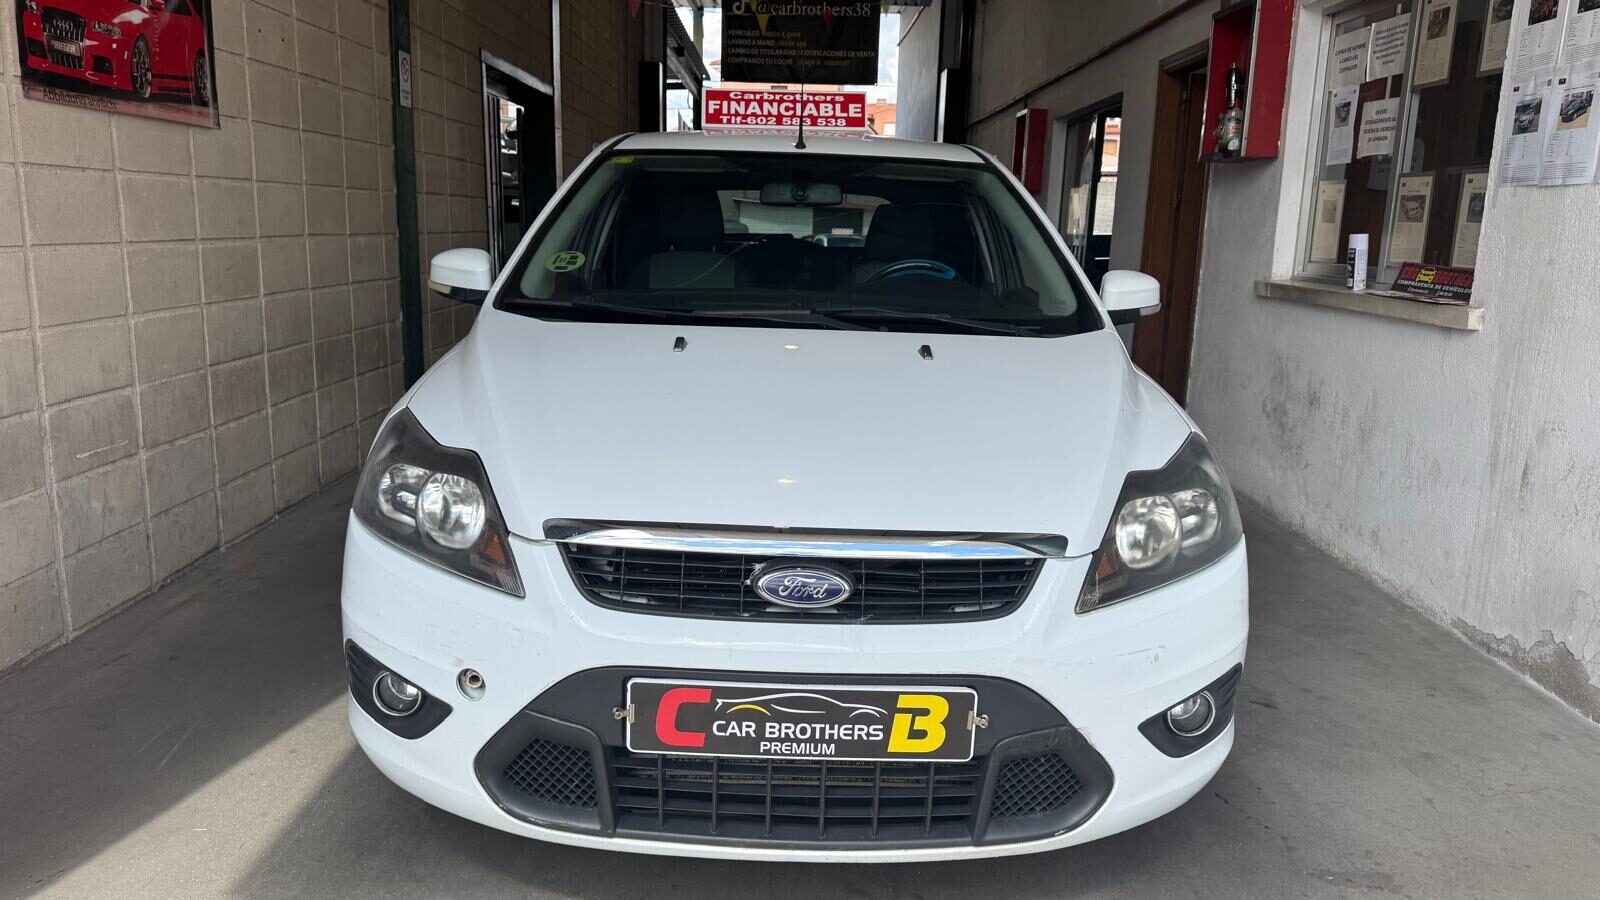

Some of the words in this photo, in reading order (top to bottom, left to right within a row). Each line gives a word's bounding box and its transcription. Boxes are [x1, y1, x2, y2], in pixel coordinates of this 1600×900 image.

[758, 0, 871, 17] @carbrothers38
[729, 91, 845, 102] Carbrothers
[708, 101, 862, 117] FINANCIABLE
[720, 115, 776, 125] Tlf-602
[782, 117, 811, 126] 583
[817, 118, 847, 127] 538
[1397, 279, 1433, 289] COMPRAVENTA
[778, 576, 828, 598] Ford
[655, 687, 712, 747] C
[712, 720, 756, 738] CAR
[765, 722, 884, 741] BROTHERS
[759, 742, 836, 756] PREMIUM
